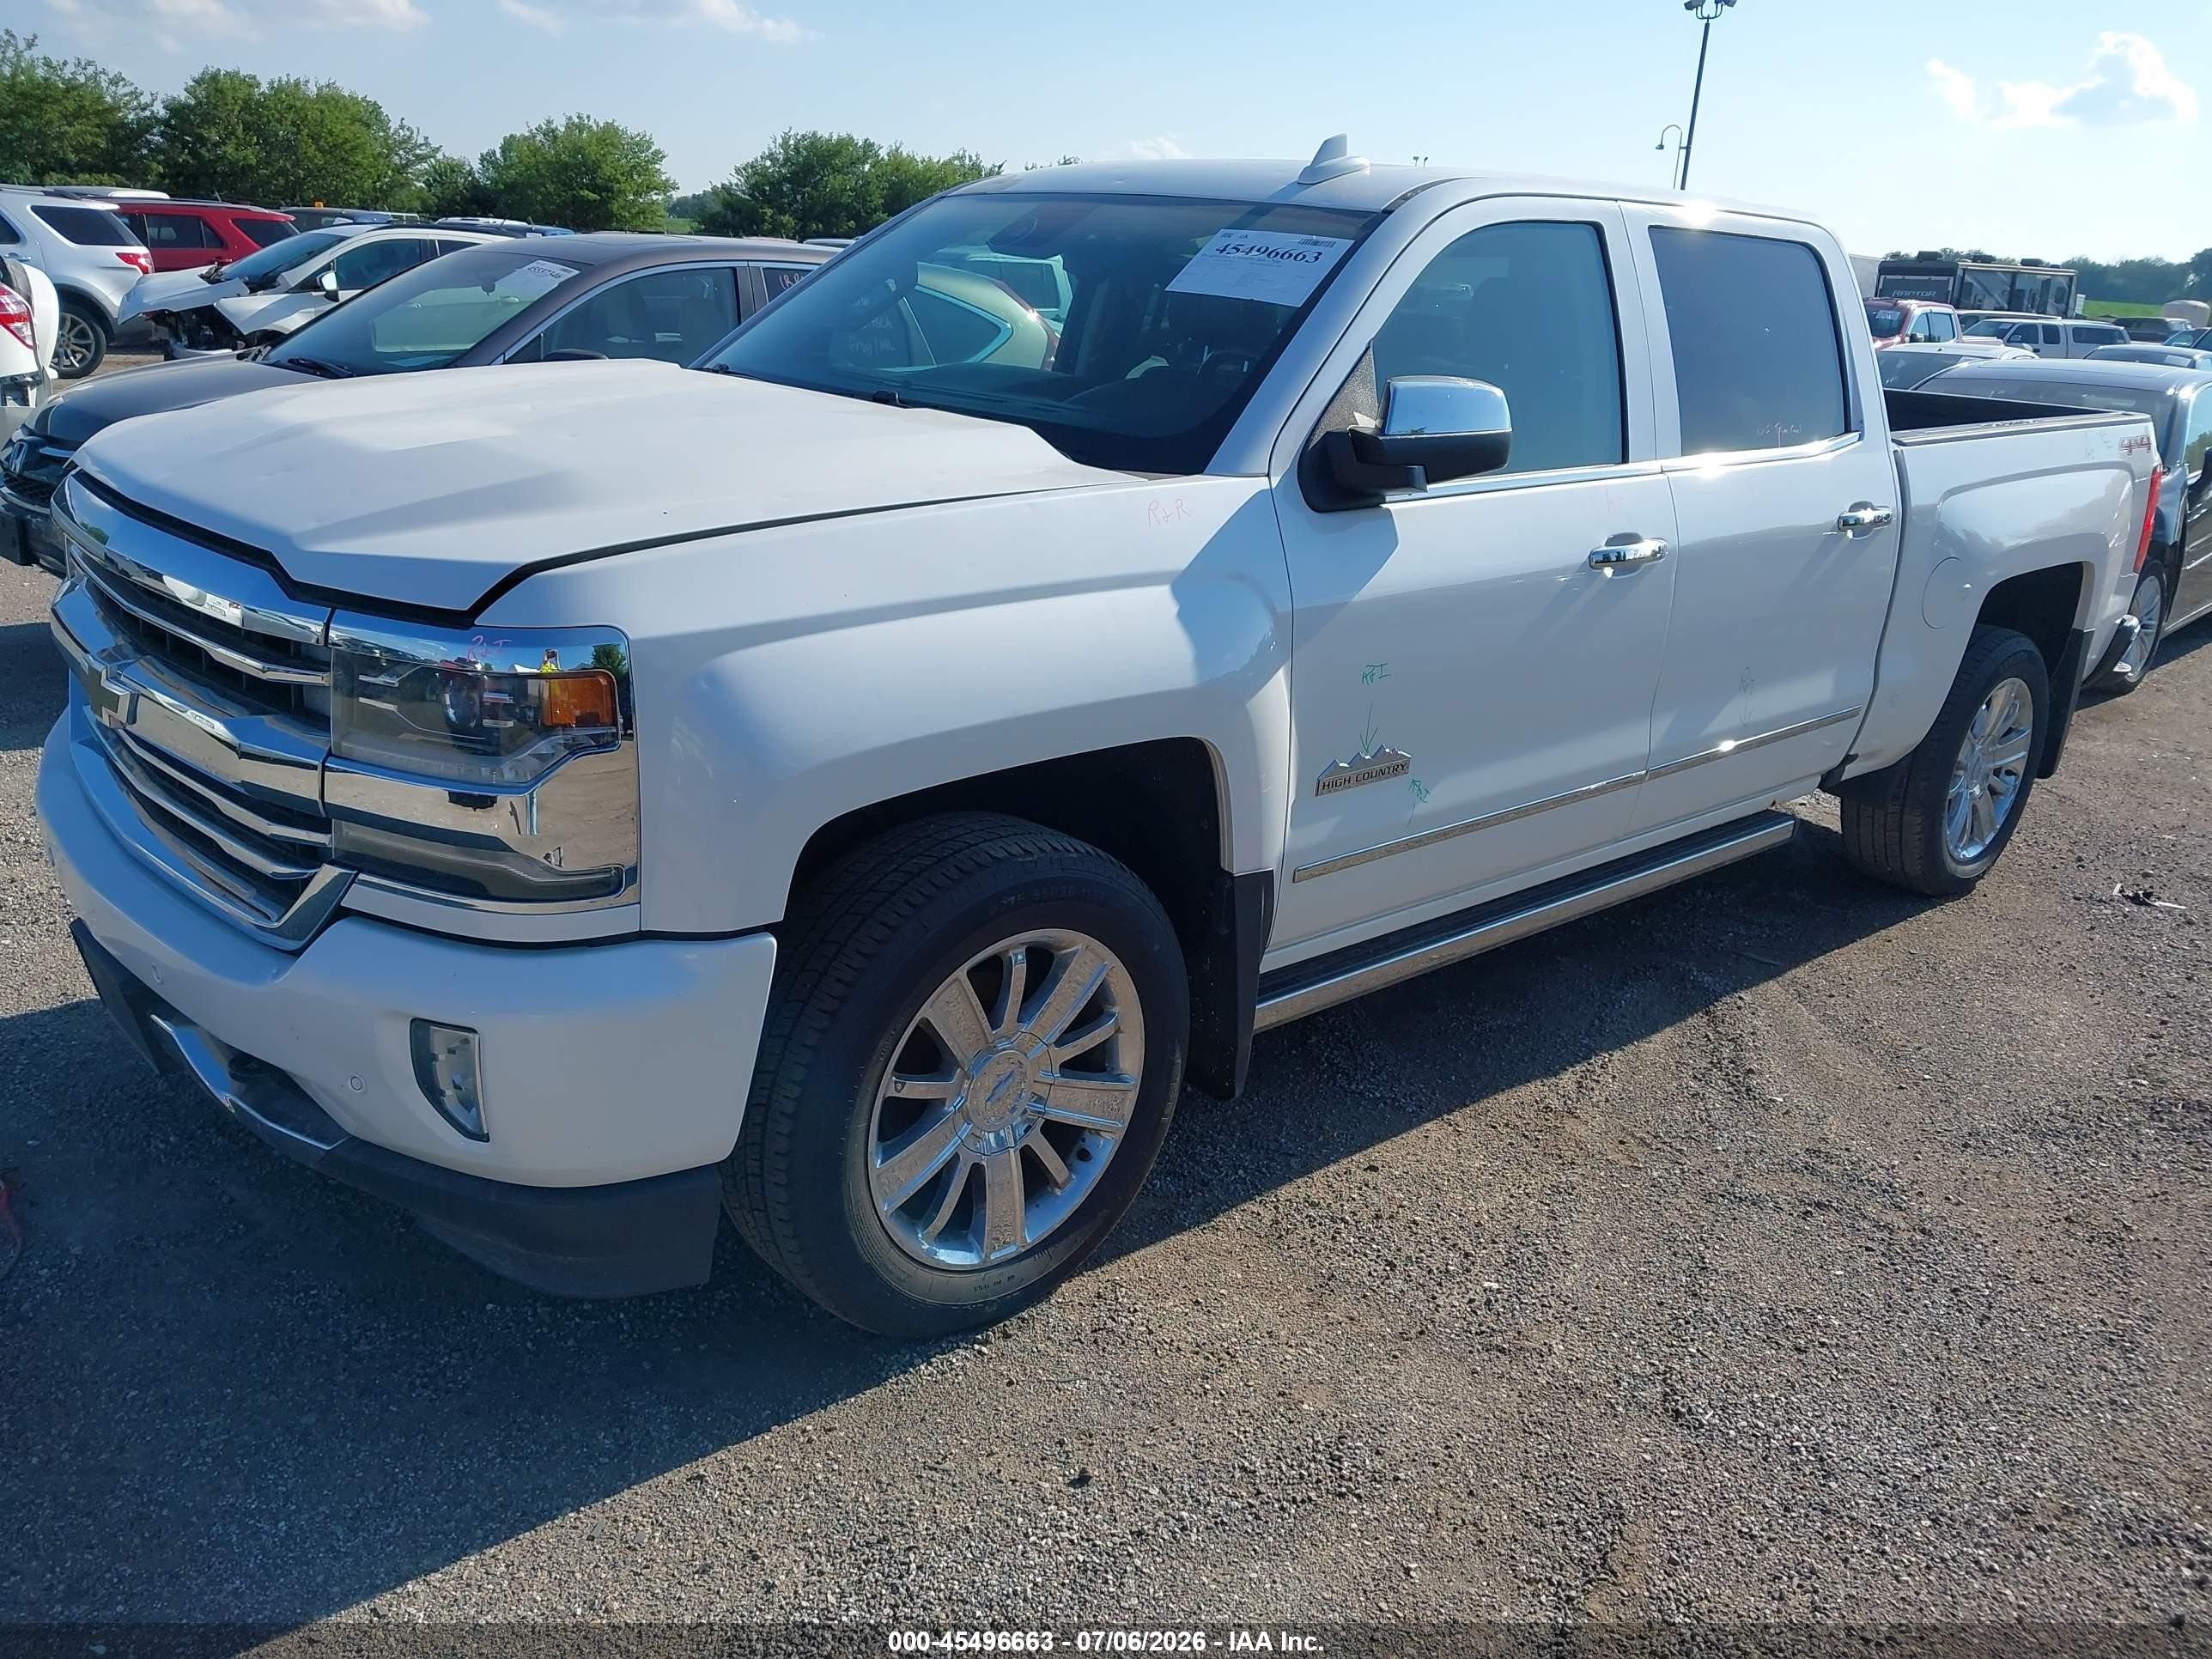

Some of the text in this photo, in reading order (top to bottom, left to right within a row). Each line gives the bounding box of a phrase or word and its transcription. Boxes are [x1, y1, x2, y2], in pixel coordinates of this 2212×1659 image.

[1216, 243, 1323, 264] 45496663
[1322, 762, 1408, 791] HIGH COUNTRY
